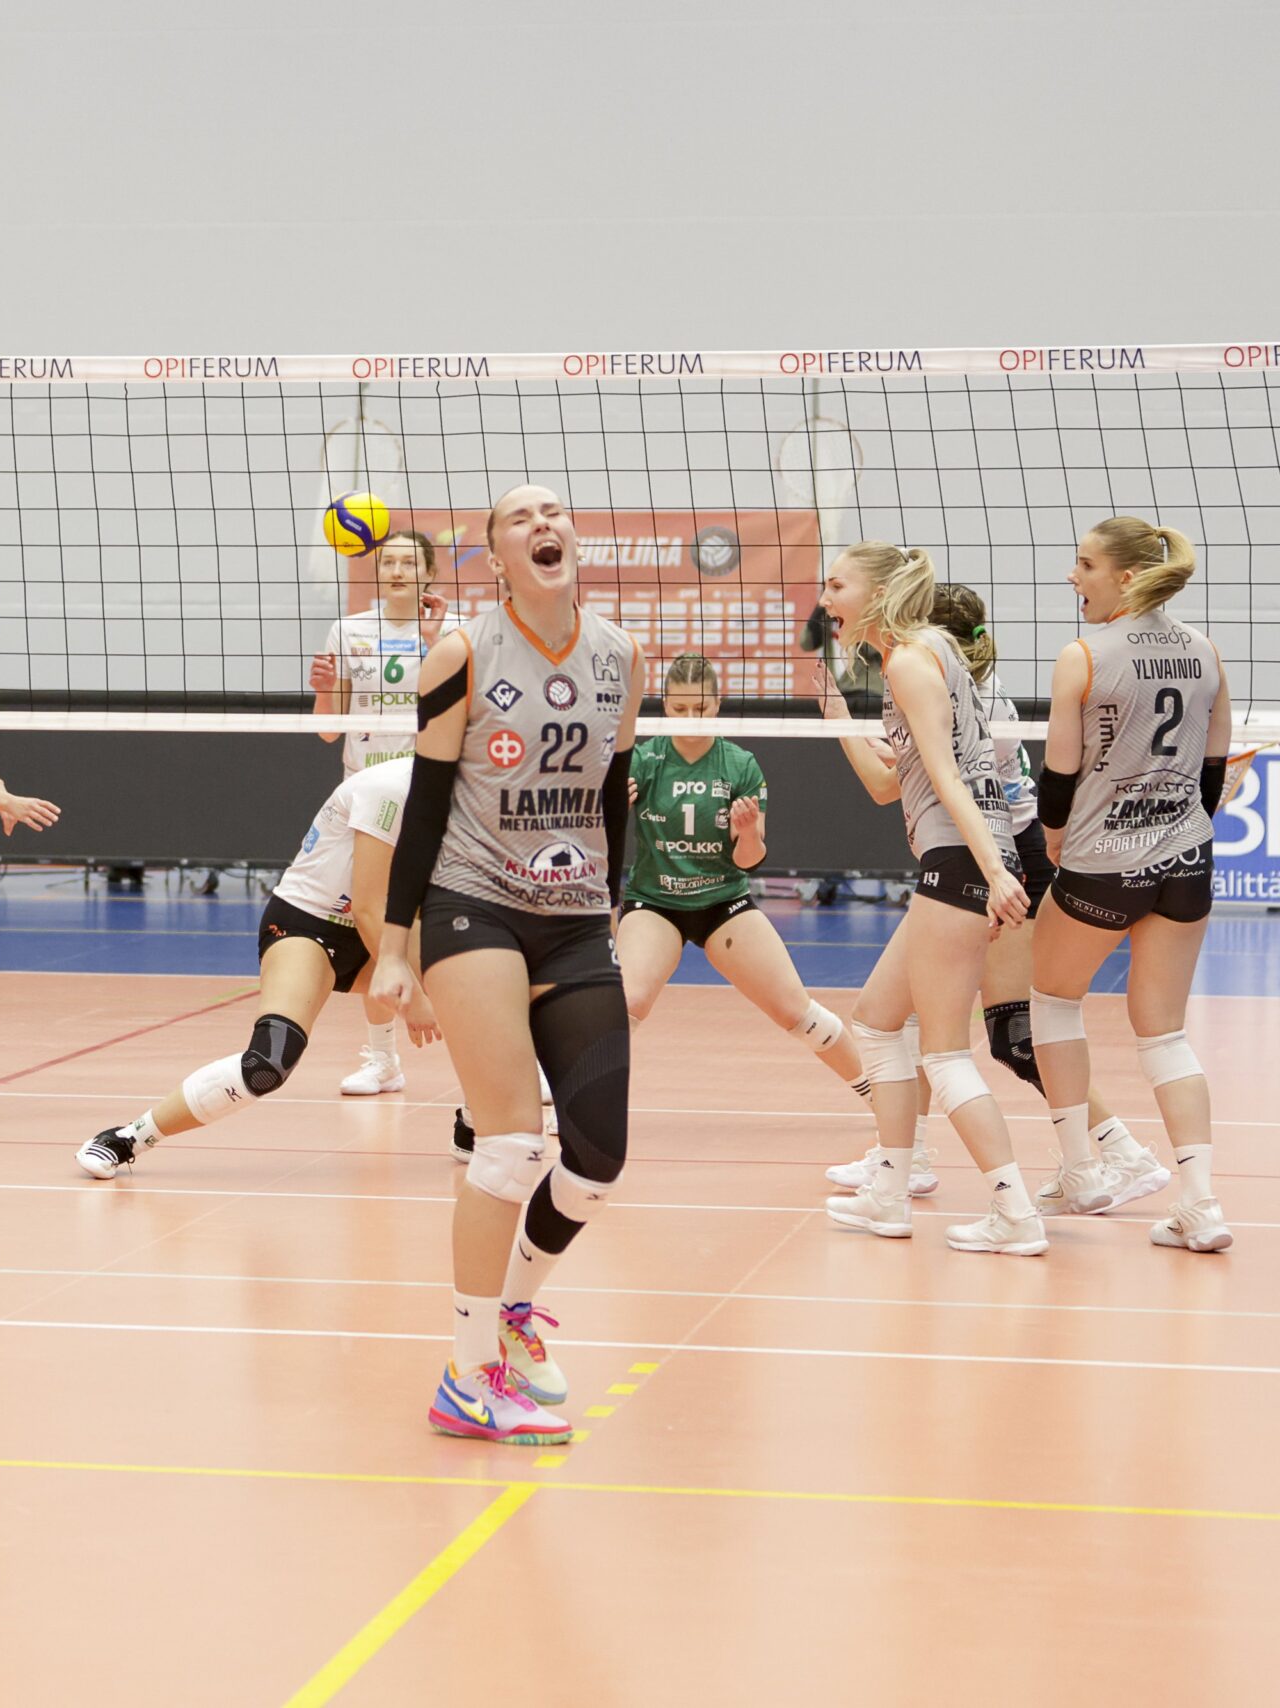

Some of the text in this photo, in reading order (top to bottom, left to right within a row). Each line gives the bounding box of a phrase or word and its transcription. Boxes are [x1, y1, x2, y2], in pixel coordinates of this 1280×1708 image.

[143, 356, 279, 379] OPIFERUM
[352, 357, 490, 379] OPIFERUM
[563, 352, 705, 376] OPIFERUM
[779, 350, 923, 375] OPIFERUM
[999, 348, 1146, 371] OPIFERUM
[384, 654, 404, 684] 6
[1132, 658, 1202, 680] YLIVAINIO
[1150, 687, 1185, 757] 2
[539, 722, 589, 774] 22
[672, 780, 707, 798] pro
[681, 803, 695, 836] 1
